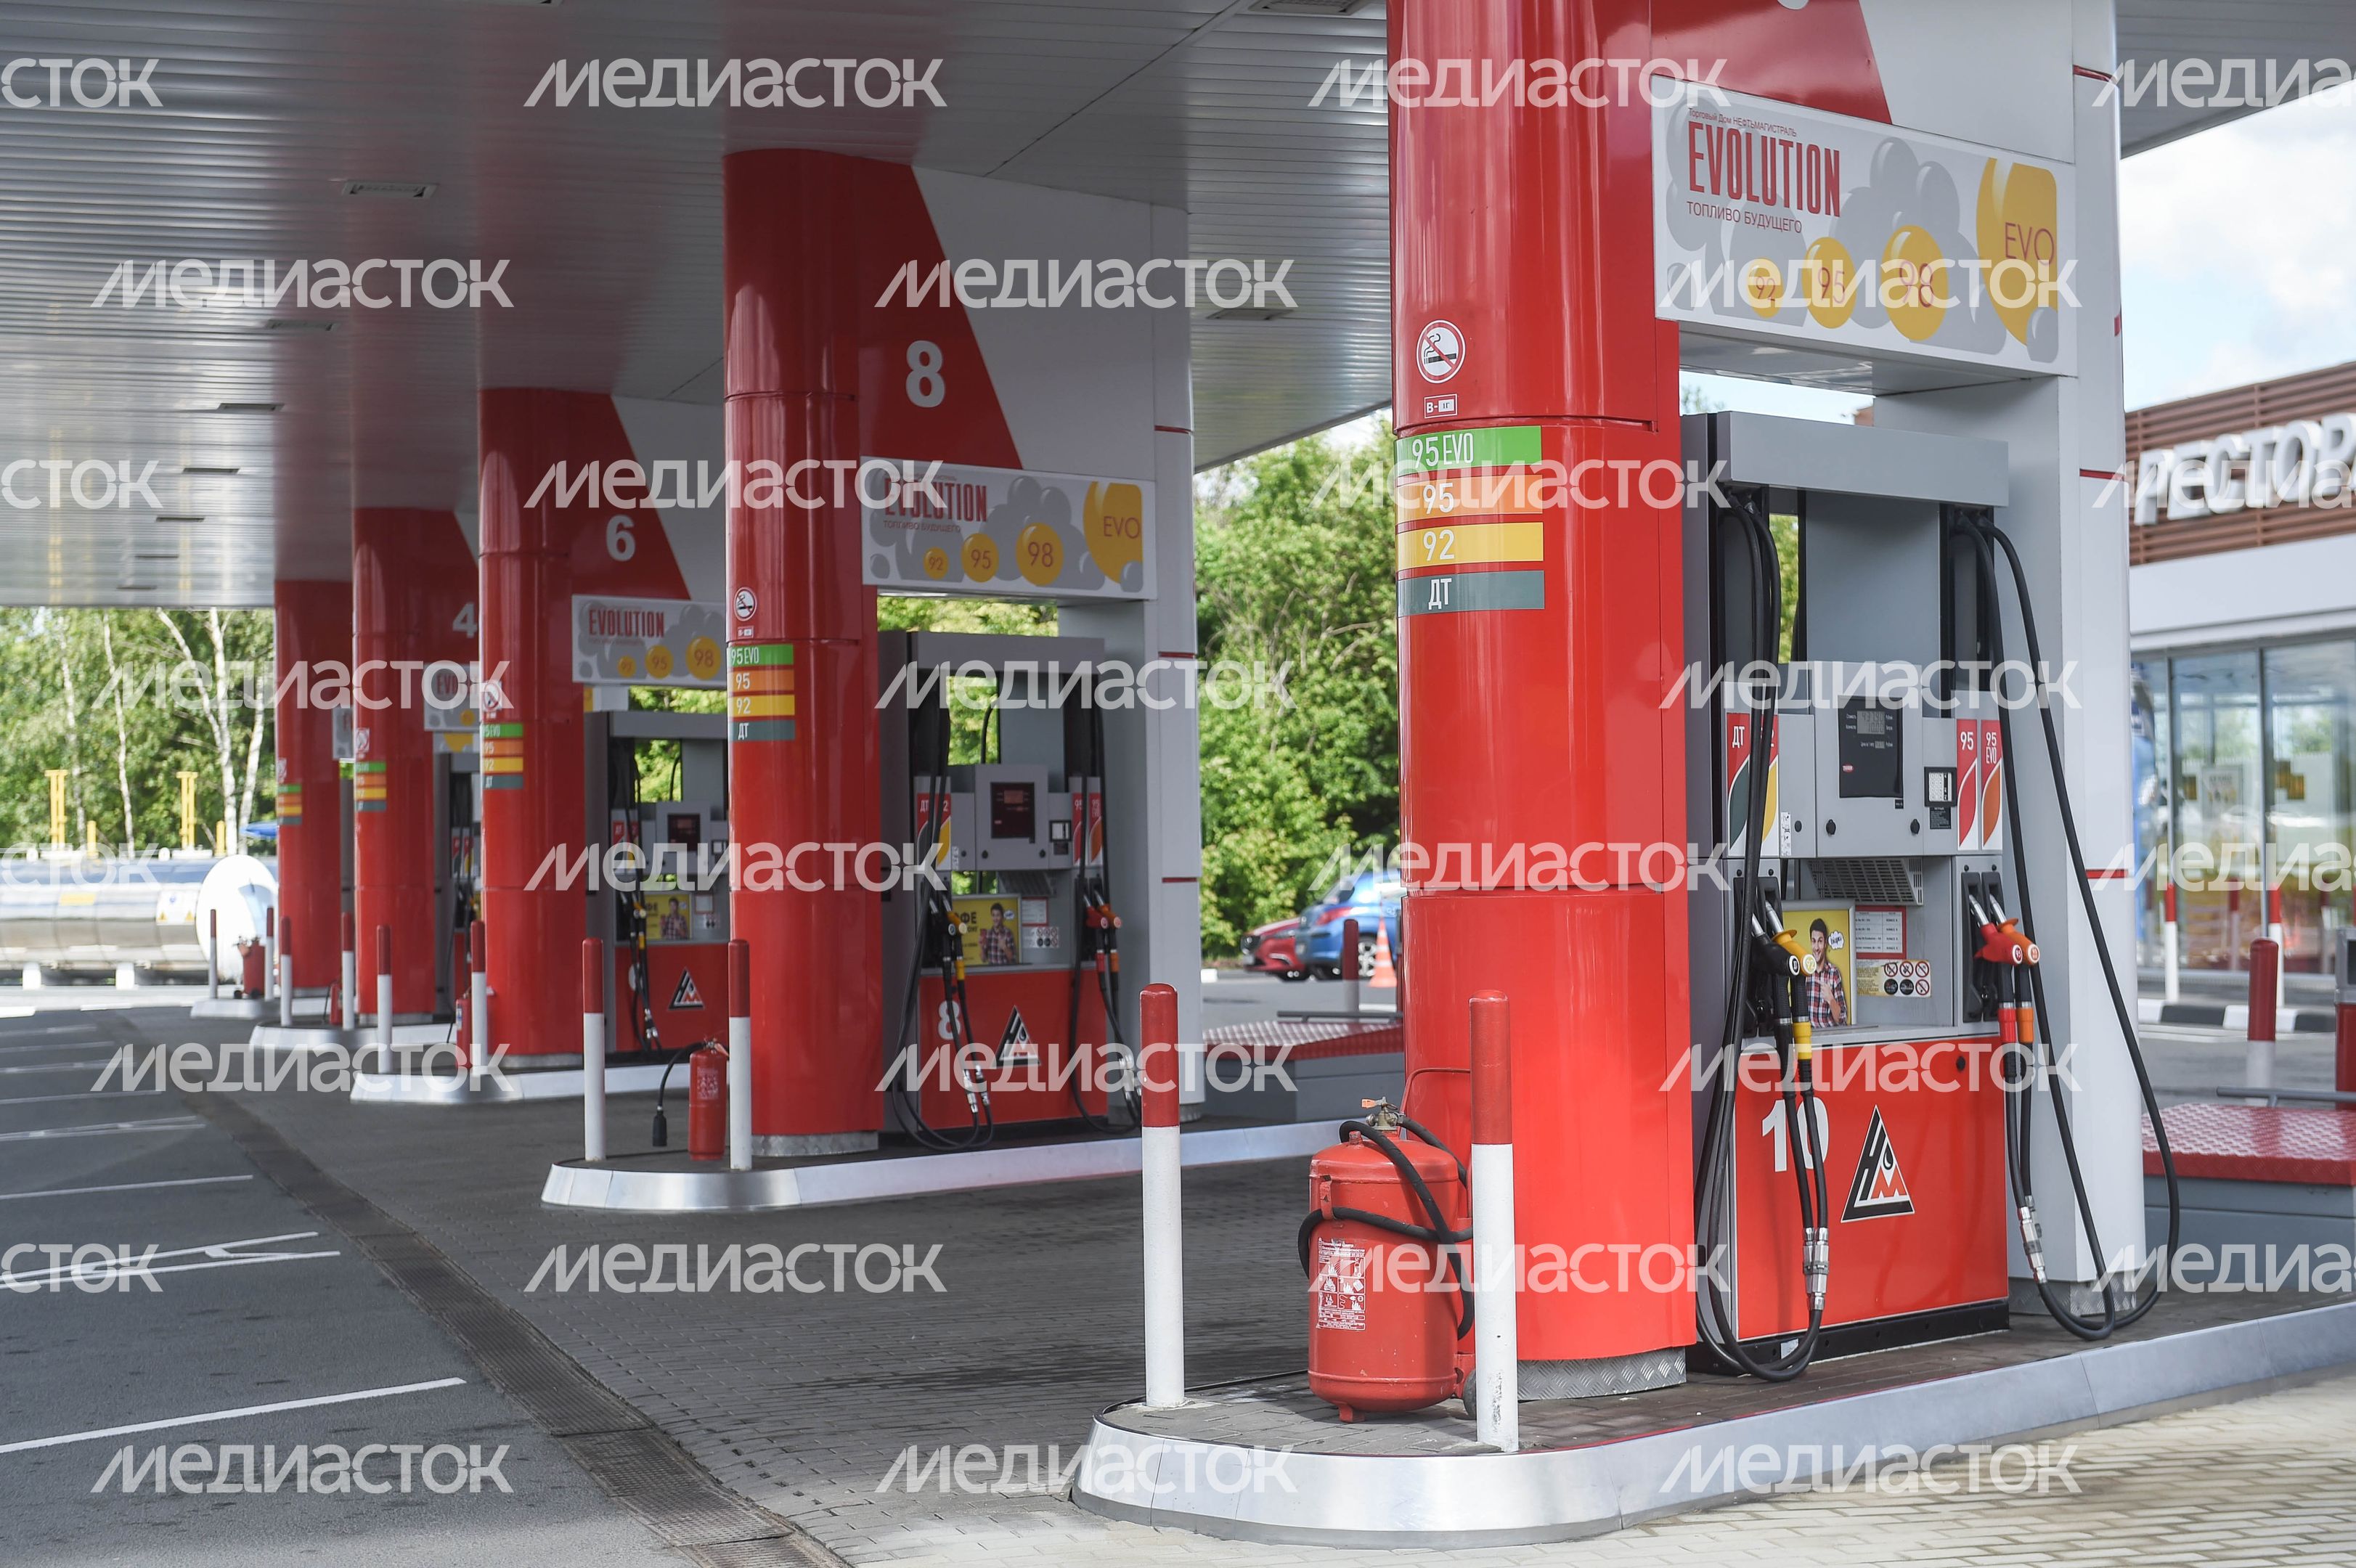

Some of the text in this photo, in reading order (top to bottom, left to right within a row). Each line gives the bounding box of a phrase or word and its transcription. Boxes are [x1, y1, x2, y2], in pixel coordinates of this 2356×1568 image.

[1688, 107, 1797, 137] Торговый Дом НЕФТЬМАГИСТРАЛЬ
[1688, 121, 1841, 217] EVOLUTION
[1687, 200, 1803, 234] ТОПЛИВО БУДУЩЕГО
[2005, 221, 2055, 266] EVO
[1756, 275, 1776, 302] 92
[1817, 266, 1846, 304] 95
[1898, 260, 1935, 309] 98
[905, 340, 946, 409] 8
[1411, 433, 1474, 468] 95 EVO
[2134, 412, 2356, 526] РЕСТОР
[884, 477, 987, 523] EVOLUTION
[1422, 482, 1454, 515] 95
[606, 513, 636, 562] 6
[1103, 515, 1141, 539] EVO
[970, 549, 992, 570] 95
[1027, 541, 1053, 568] 98
[1423, 528, 1455, 562] 92
[929, 556, 943, 571] 92
[1428, 577, 1452, 611] ДТ
[452, 603, 478, 639] 4
[589, 608, 665, 638] EVOLUTION
[652, 656, 667, 671] 95
[693, 648, 714, 668] 98
[731, 646, 759, 666] 95 EVO
[735, 672, 751, 690] 95
[736, 697, 751, 714] 92
[738, 722, 749, 740] ДТ
[1732, 726, 1745, 748] ДТ
[1960, 731, 1974, 751] 95
[1986, 732, 1997, 746] 95
[1986, 747, 1997, 764] EVO
[1805, 958, 1815, 970] 92
[938, 1000, 961, 1041] 8
[1762, 1096, 1830, 1172] 10
